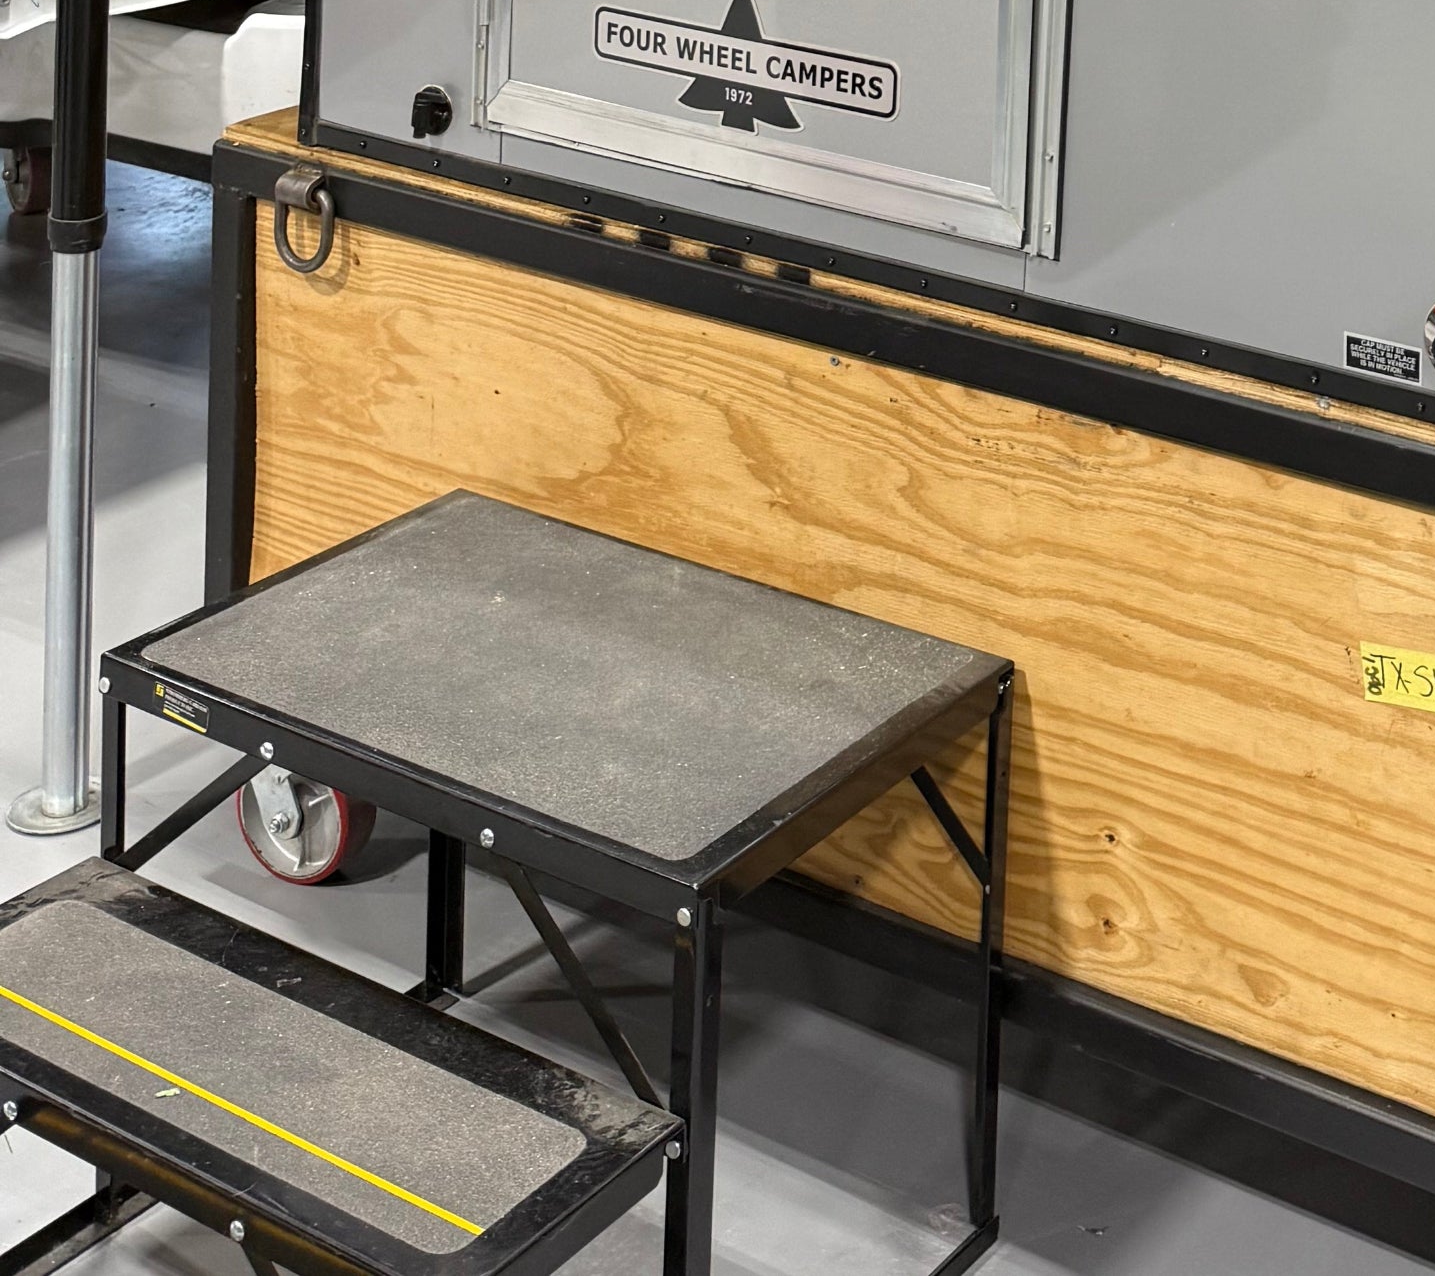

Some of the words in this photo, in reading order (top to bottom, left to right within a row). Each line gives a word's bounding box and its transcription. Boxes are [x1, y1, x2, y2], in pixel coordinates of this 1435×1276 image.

[606, 22, 668, 56] FOUR
[676, 35, 758, 75] WHEEL
[766, 55, 884, 100] CAMPERS
[724, 86, 753, 106] 1972
[1350, 343, 1385, 356] SECURELY
[1394, 354, 1416, 364] PLACE
[1360, 339, 1375, 347] CAP
[1376, 342, 1394, 352] MUST
[1350, 351, 1371, 360] WHILE
[1373, 355, 1386, 364] THE
[1387, 358, 1416, 371] VEHICLE
